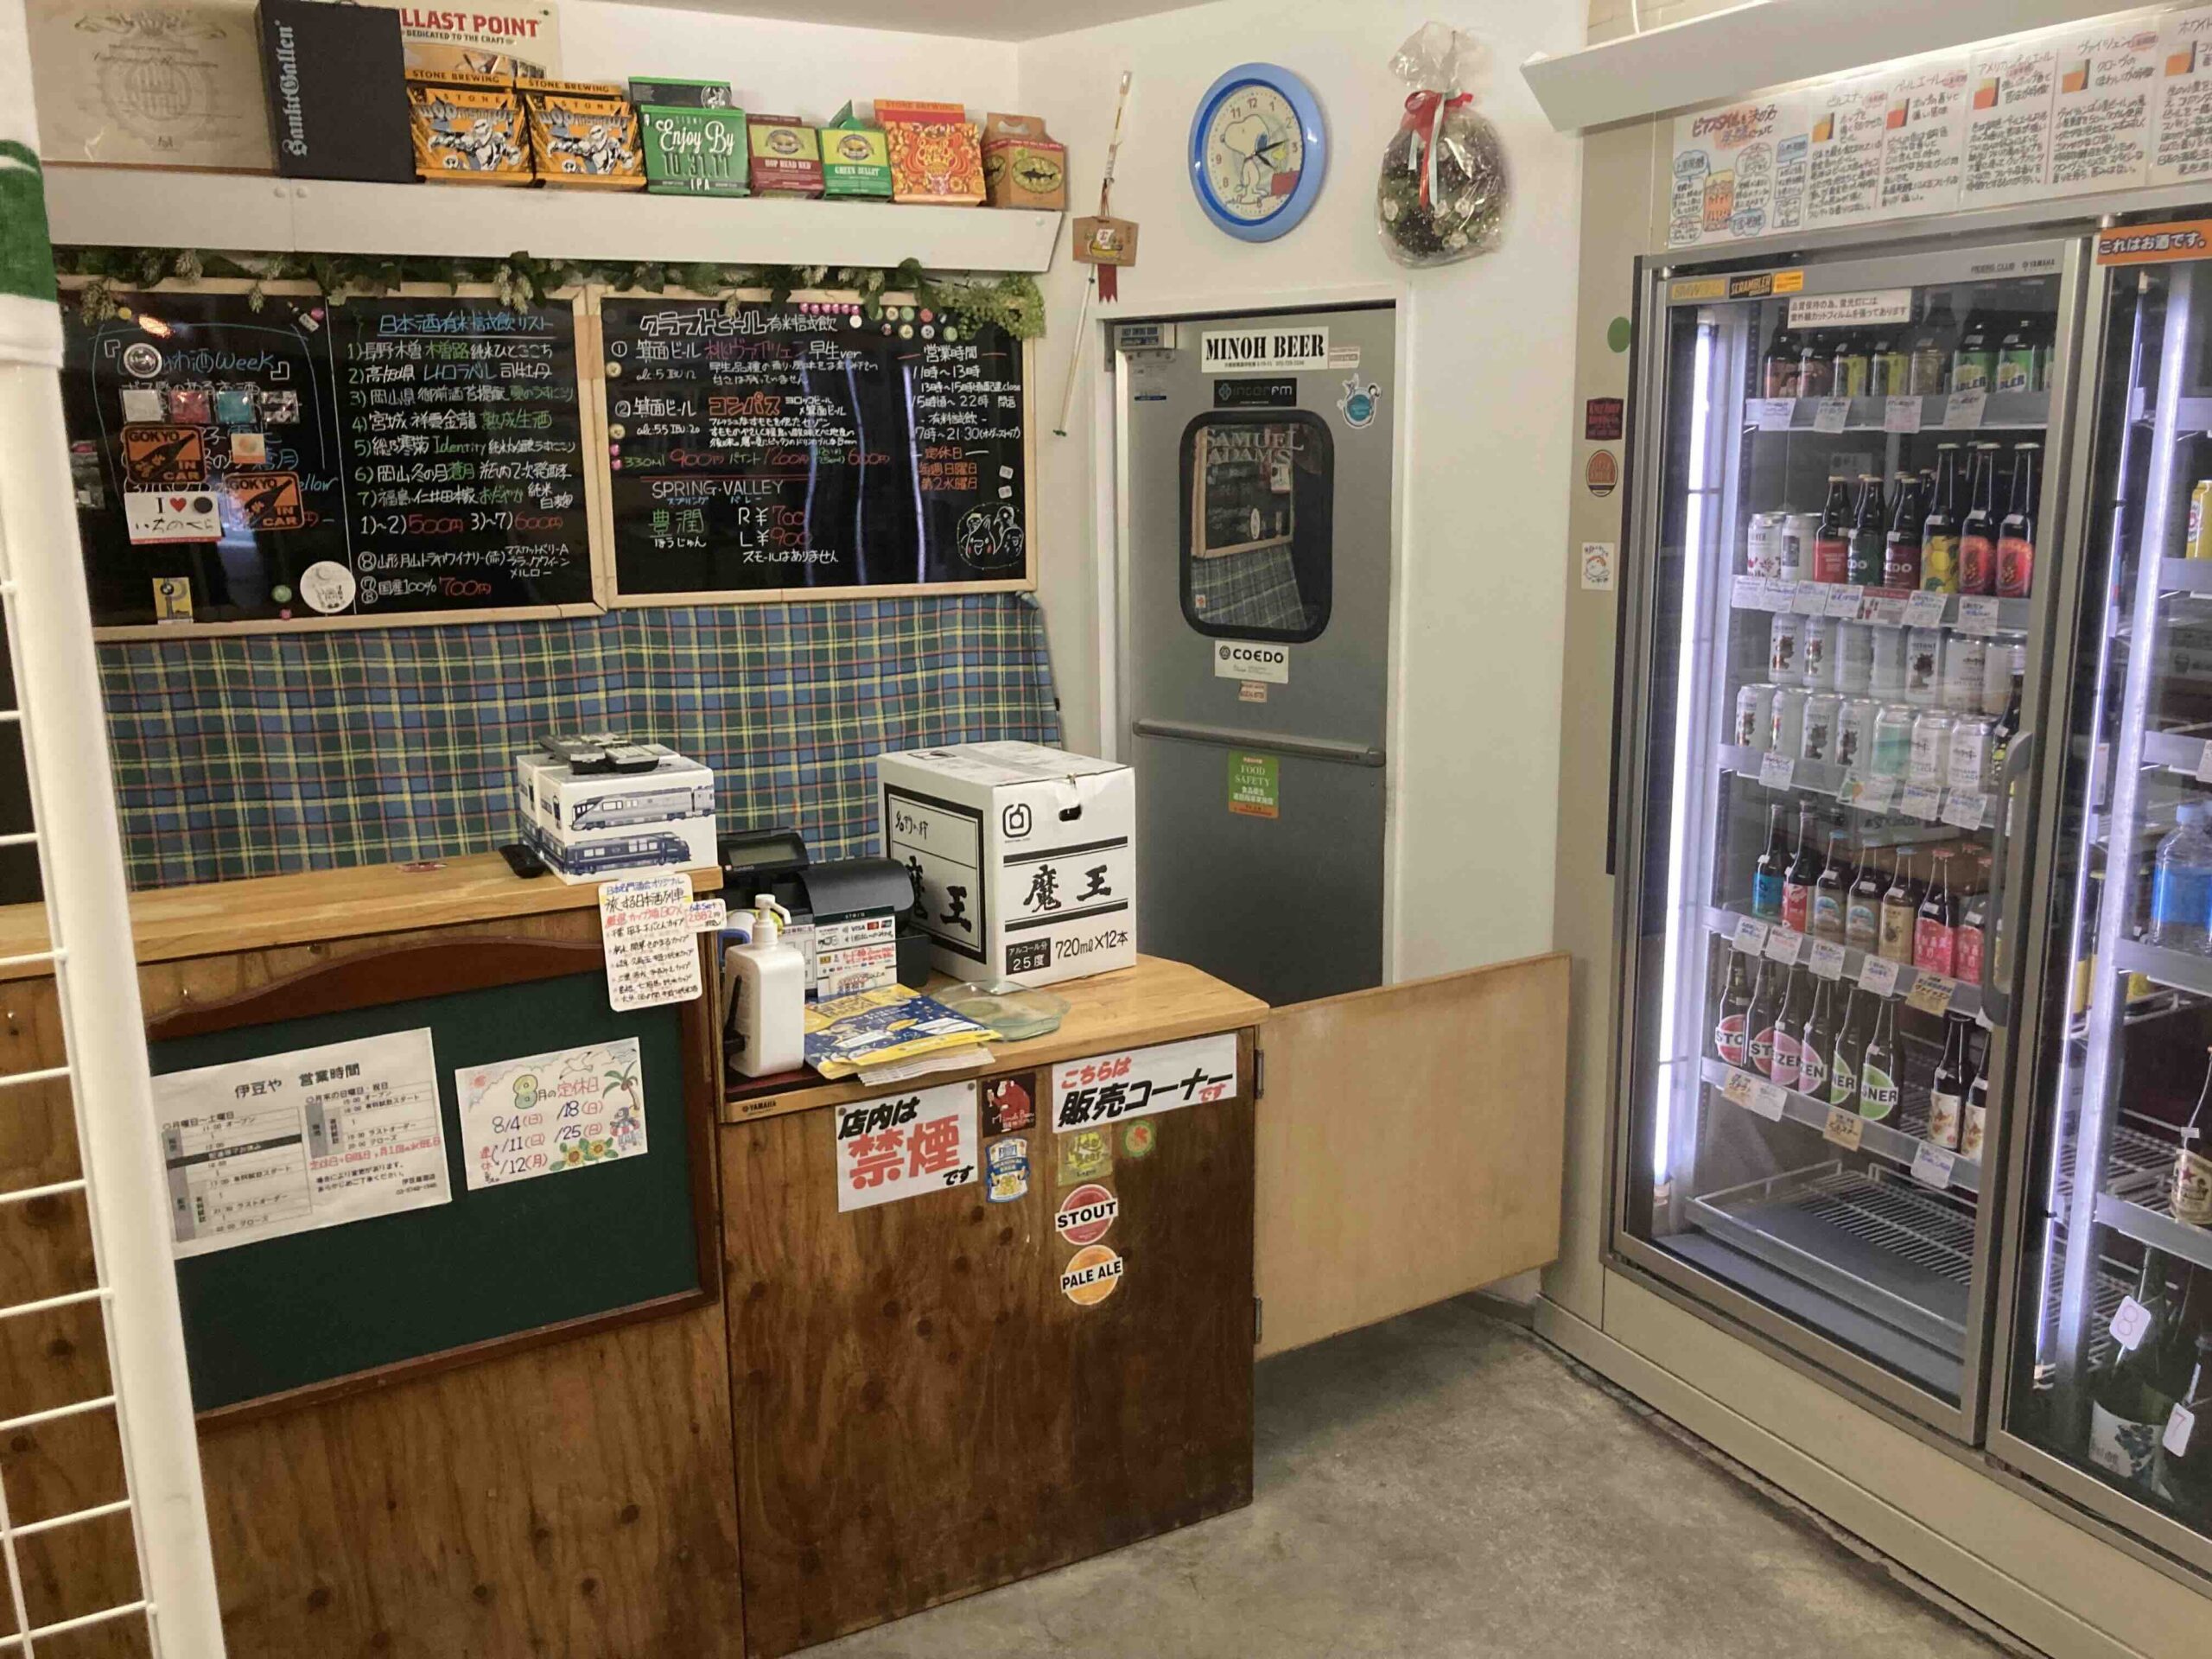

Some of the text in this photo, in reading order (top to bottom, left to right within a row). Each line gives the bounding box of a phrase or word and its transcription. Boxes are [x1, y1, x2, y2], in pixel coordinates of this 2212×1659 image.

[401, 9, 538, 37] LLAST POINT
[406, 30, 449, 40] DEDICATED
[480, 35, 505, 45] CRAFT
[412, 69, 500, 84] STONE BREWING
[528, 79, 610, 93] STONE BREWING
[444, 93, 502, 105] STONE
[1248, 98, 1258, 109] 12
[1231, 107, 1242, 118] 11
[656, 118, 702, 154] Enjoy
[705, 120, 734, 156] By
[690, 177, 710, 191] IPA
[2098, 231, 2206, 255] これはお酒です。
[1731, 275, 1771, 295] SCRAMBLER
[923, 343, 978, 363] 営業時間
[1206, 335, 1267, 360] MINOH
[1274, 333, 1325, 359] BEER
[709, 391, 782, 416] コンパス
[129, 432, 180, 443] GOKYO
[434, 435, 486, 457] Identity
[1206, 425, 1305, 451] SAMUEL
[178, 460, 196, 469] IN
[1208, 448, 1292, 465] ADAMS
[163, 472, 200, 480] CAR
[229, 477, 277, 490] GOKYO
[299, 474, 339, 493] ellow
[276, 505, 294, 515] IN
[738, 507, 751, 524] R
[263, 517, 298, 526] CAR
[654, 537, 707, 549] ほうじゅん
[740, 531, 753, 548] L
[742, 549, 839, 564] スモールはありません
[439, 576, 492, 596] 700円
[1233, 648, 1284, 664] COEDO
[1241, 765, 1266, 776] FOOD
[1235, 773, 1272, 787] SAFETY
[1007, 938, 1048, 957] アルコール分
[1012, 954, 1046, 972] 25度
[234, 1063, 360, 1099] 伊豆や 営業時間
[1061, 1056, 1132, 1090] こちらは
[512, 1074, 600, 1109] 8月の定休日
[1058, 1067, 1233, 1128] 販売コーナー
[1198, 1084, 1226, 1103] です
[748, 1100, 777, 1111] YAMAHA
[838, 1096, 920, 1140] 店内は
[848, 1115, 960, 1190] 禁煙
[943, 1166, 975, 1185] です
[1057, 1201, 1117, 1229] STOUT
[1062, 1260, 1122, 1290] PALE ALE
